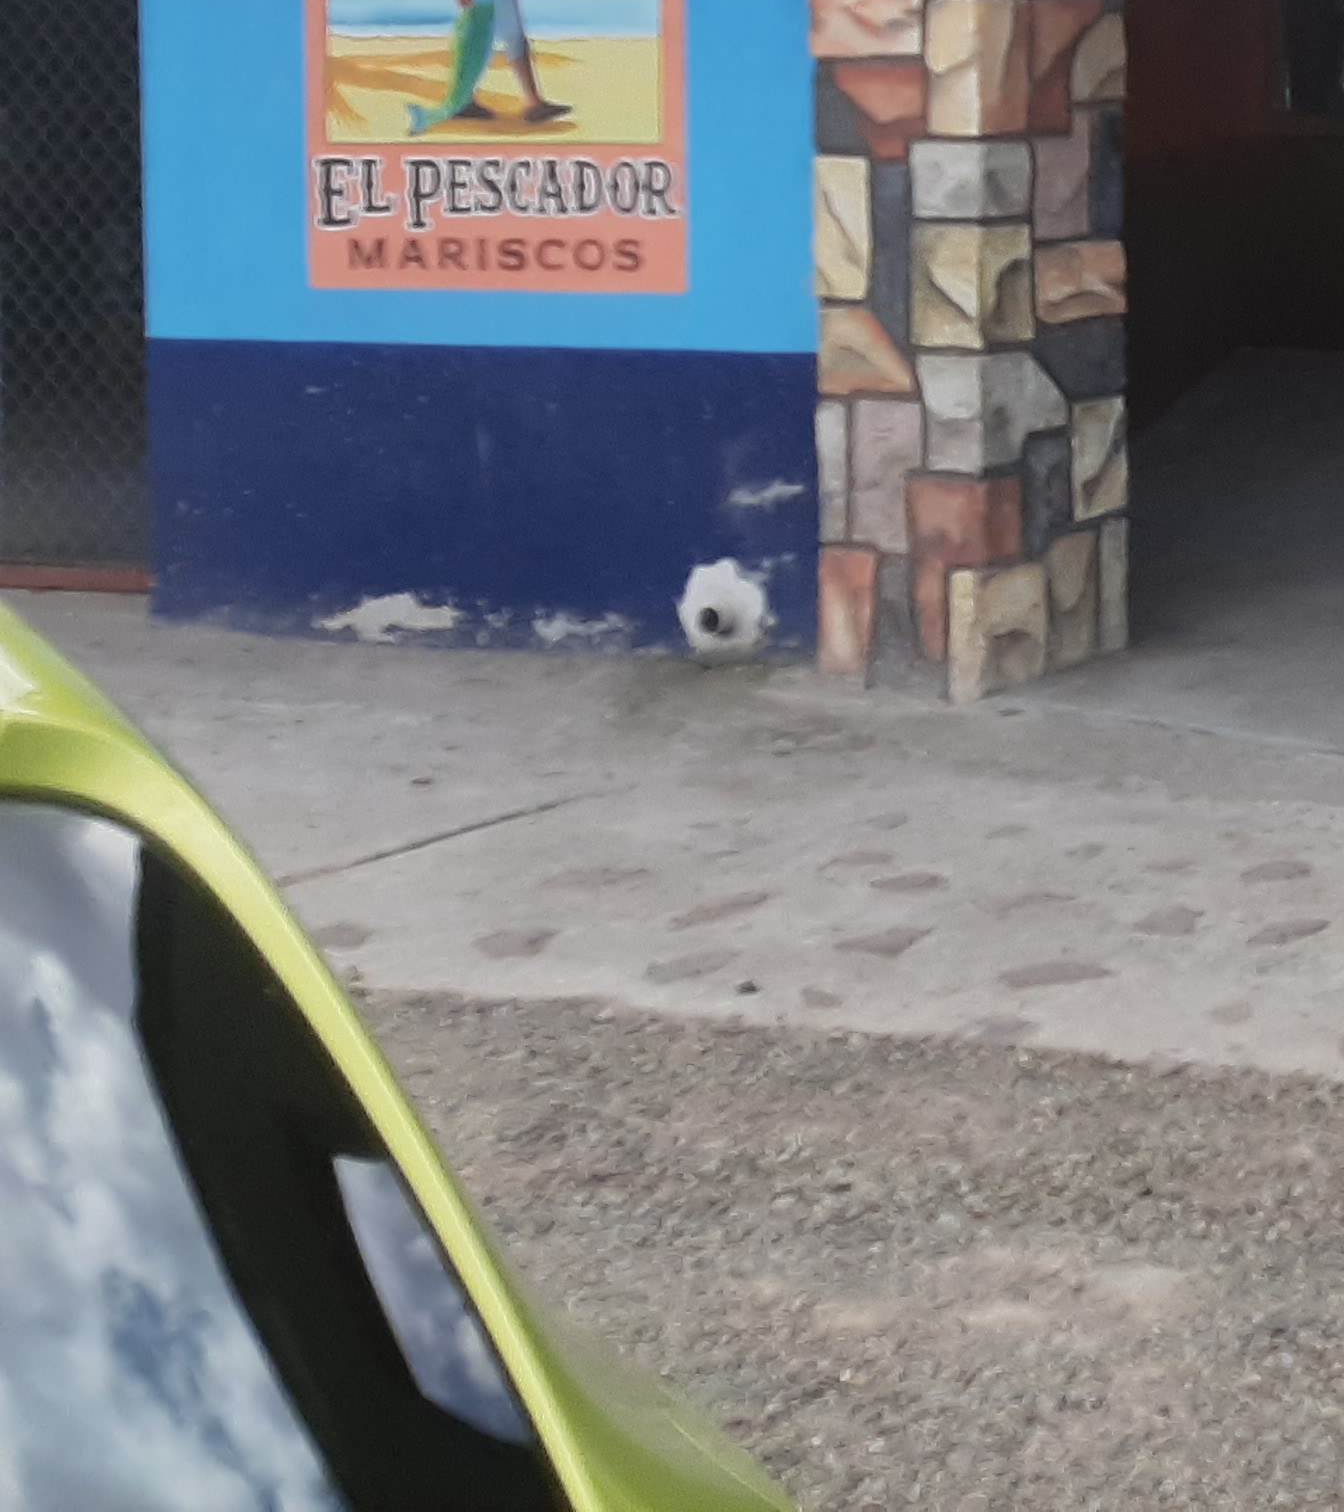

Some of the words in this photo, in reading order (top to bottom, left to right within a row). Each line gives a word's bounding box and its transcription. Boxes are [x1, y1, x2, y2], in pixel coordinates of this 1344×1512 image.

[312, 156, 394, 230] EL
[402, 156, 681, 230] PESCADOR
[349, 238, 644, 272] MARISCOS
